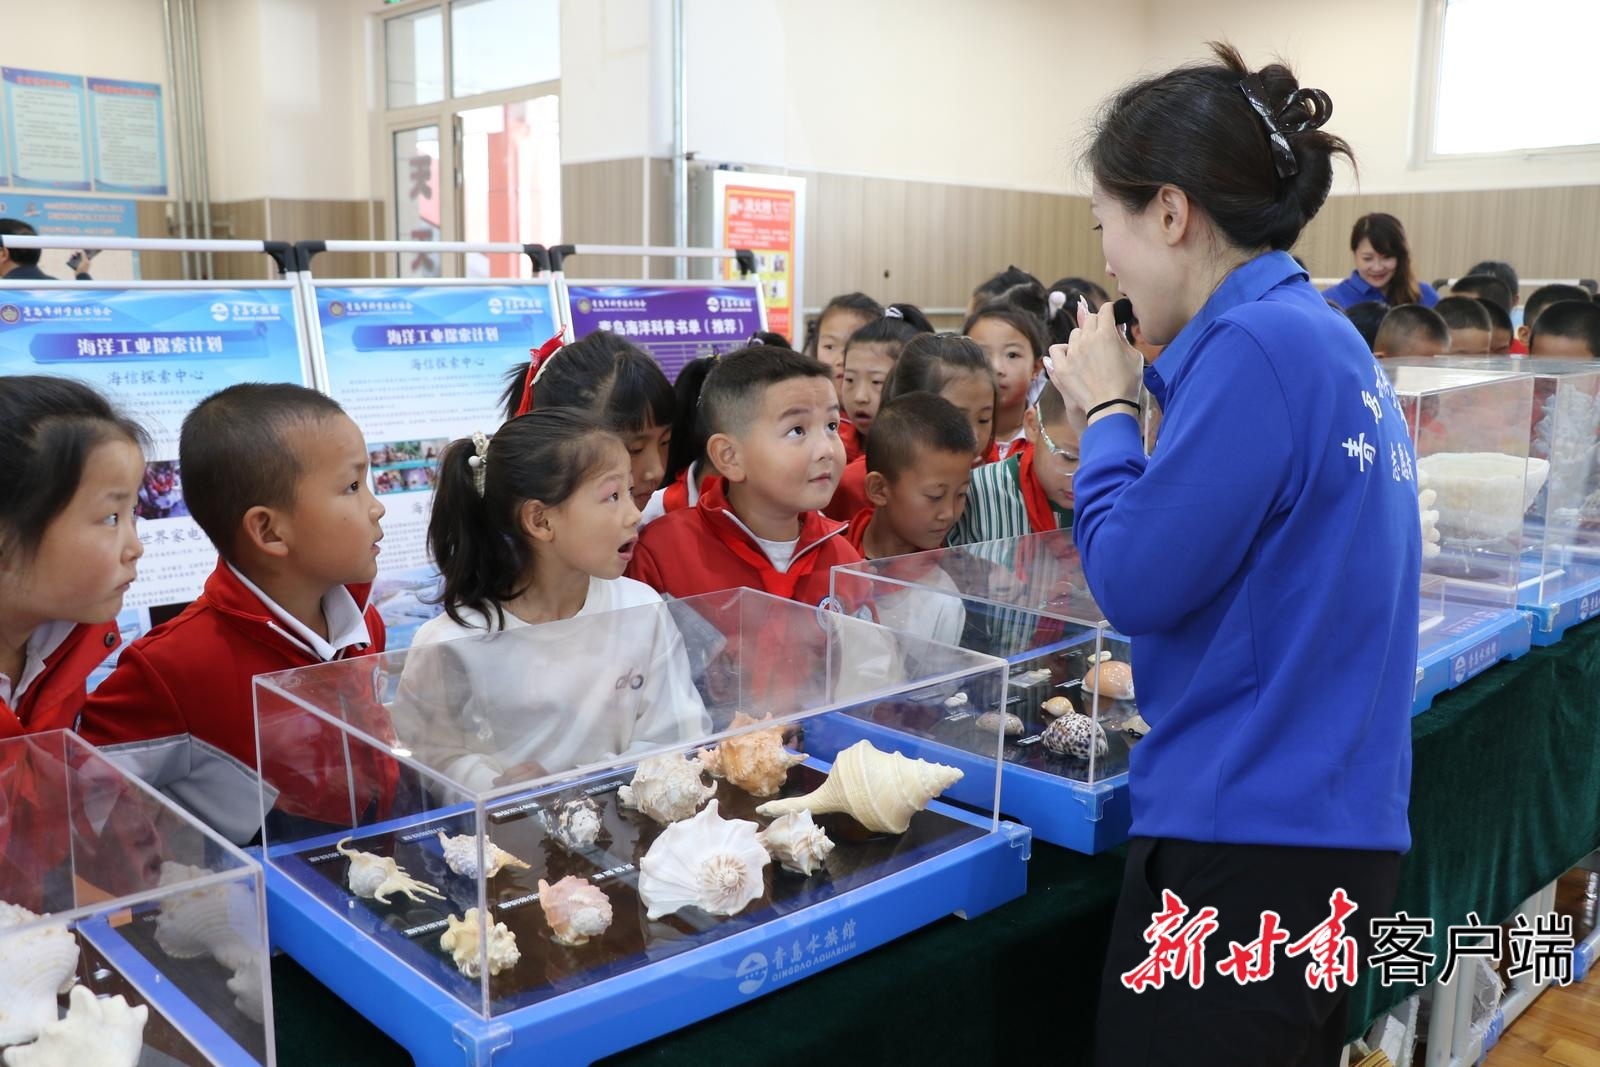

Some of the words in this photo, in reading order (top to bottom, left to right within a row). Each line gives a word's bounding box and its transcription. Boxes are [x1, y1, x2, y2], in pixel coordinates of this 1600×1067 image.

[387, 327, 499, 345] 海洋工业探索计划
[77, 336, 223, 356] 海洋工业探索计划
[107, 368, 204, 386] 海信探索中心
[772, 961, 812, 982] QINGDAO
[813, 940, 857, 966] AQUARIUM
